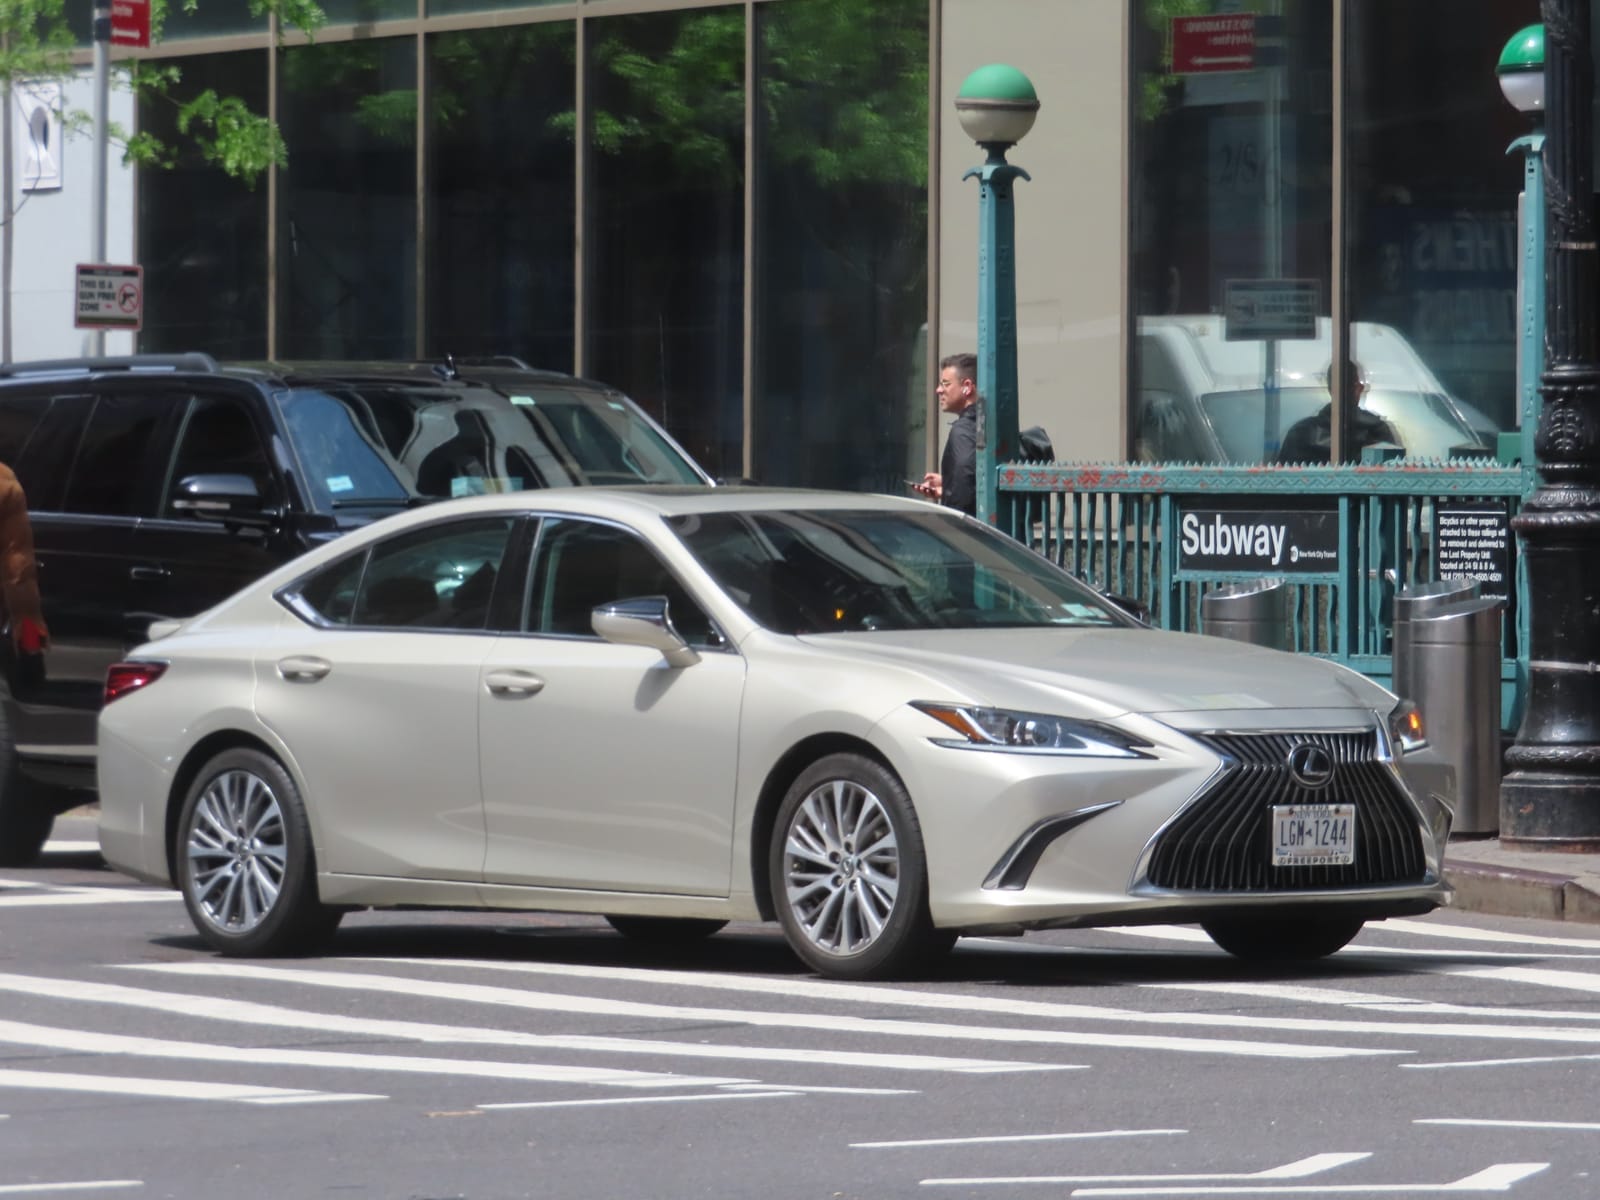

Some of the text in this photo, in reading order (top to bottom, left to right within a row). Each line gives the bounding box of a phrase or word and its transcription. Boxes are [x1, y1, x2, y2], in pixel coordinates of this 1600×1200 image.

[80, 302, 99, 312] ZONE
[1440, 517, 1459, 526] Bicycles
[1466, 517, 1478, 525] other
[1479, 518, 1498, 527] property
[1440, 528, 1460, 536] attached
[1468, 528, 1480, 536] these
[1182, 513, 1286, 566] Subway
[1478, 540, 1498, 548] delivered
[1499, 540, 1504, 548] to
[1461, 550, 1480, 560] Property
[1315, 819, 1347, 846] 1244
